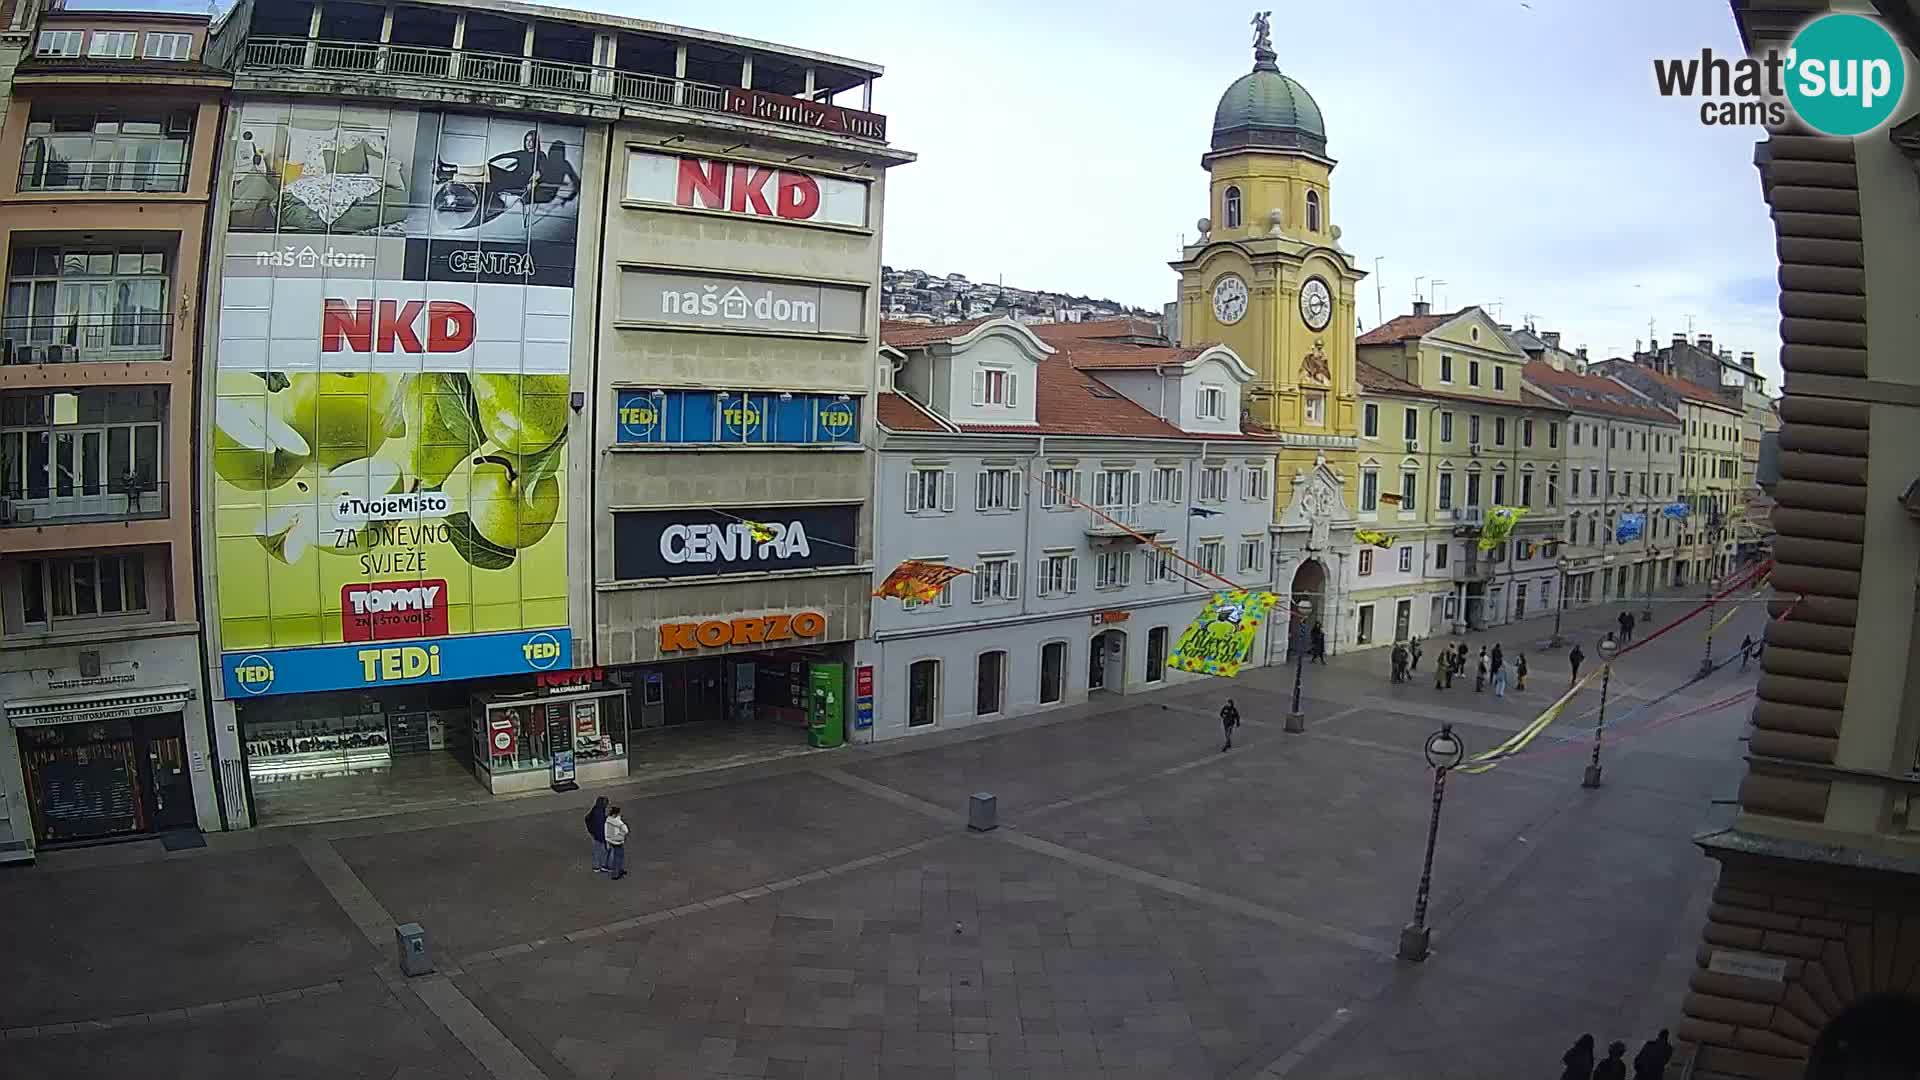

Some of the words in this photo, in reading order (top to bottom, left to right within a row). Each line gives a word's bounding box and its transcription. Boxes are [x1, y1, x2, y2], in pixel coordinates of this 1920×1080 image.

[752, 94, 823, 128] Rendez
[839, 113, 883, 138] Vous
[676, 158, 820, 219] NKD
[257, 247, 295, 266] naš
[320, 248, 366, 268] dom
[450, 250, 535, 276] CENTRA
[661, 285, 718, 316] naš
[754, 290, 816, 323] dom
[322, 297, 478, 354] NKD
[619, 407, 658, 425] TEDi
[724, 409, 760, 425] TEDi
[820, 411, 853, 426] TEDi
[338, 497, 447, 518] #TvojeMisto
[334, 528, 358, 549] ZA
[367, 524, 451, 548] DNEVNO
[659, 520, 811, 564] CENTRA
[359, 548, 427, 575] SVJEŽE
[349, 586, 440, 614] TOMMY
[659, 611, 826, 652] KORZO
[359, 645, 441, 682] TEDi
[523, 643, 560, 660] TEDi
[235, 663, 274, 683] TEDi
